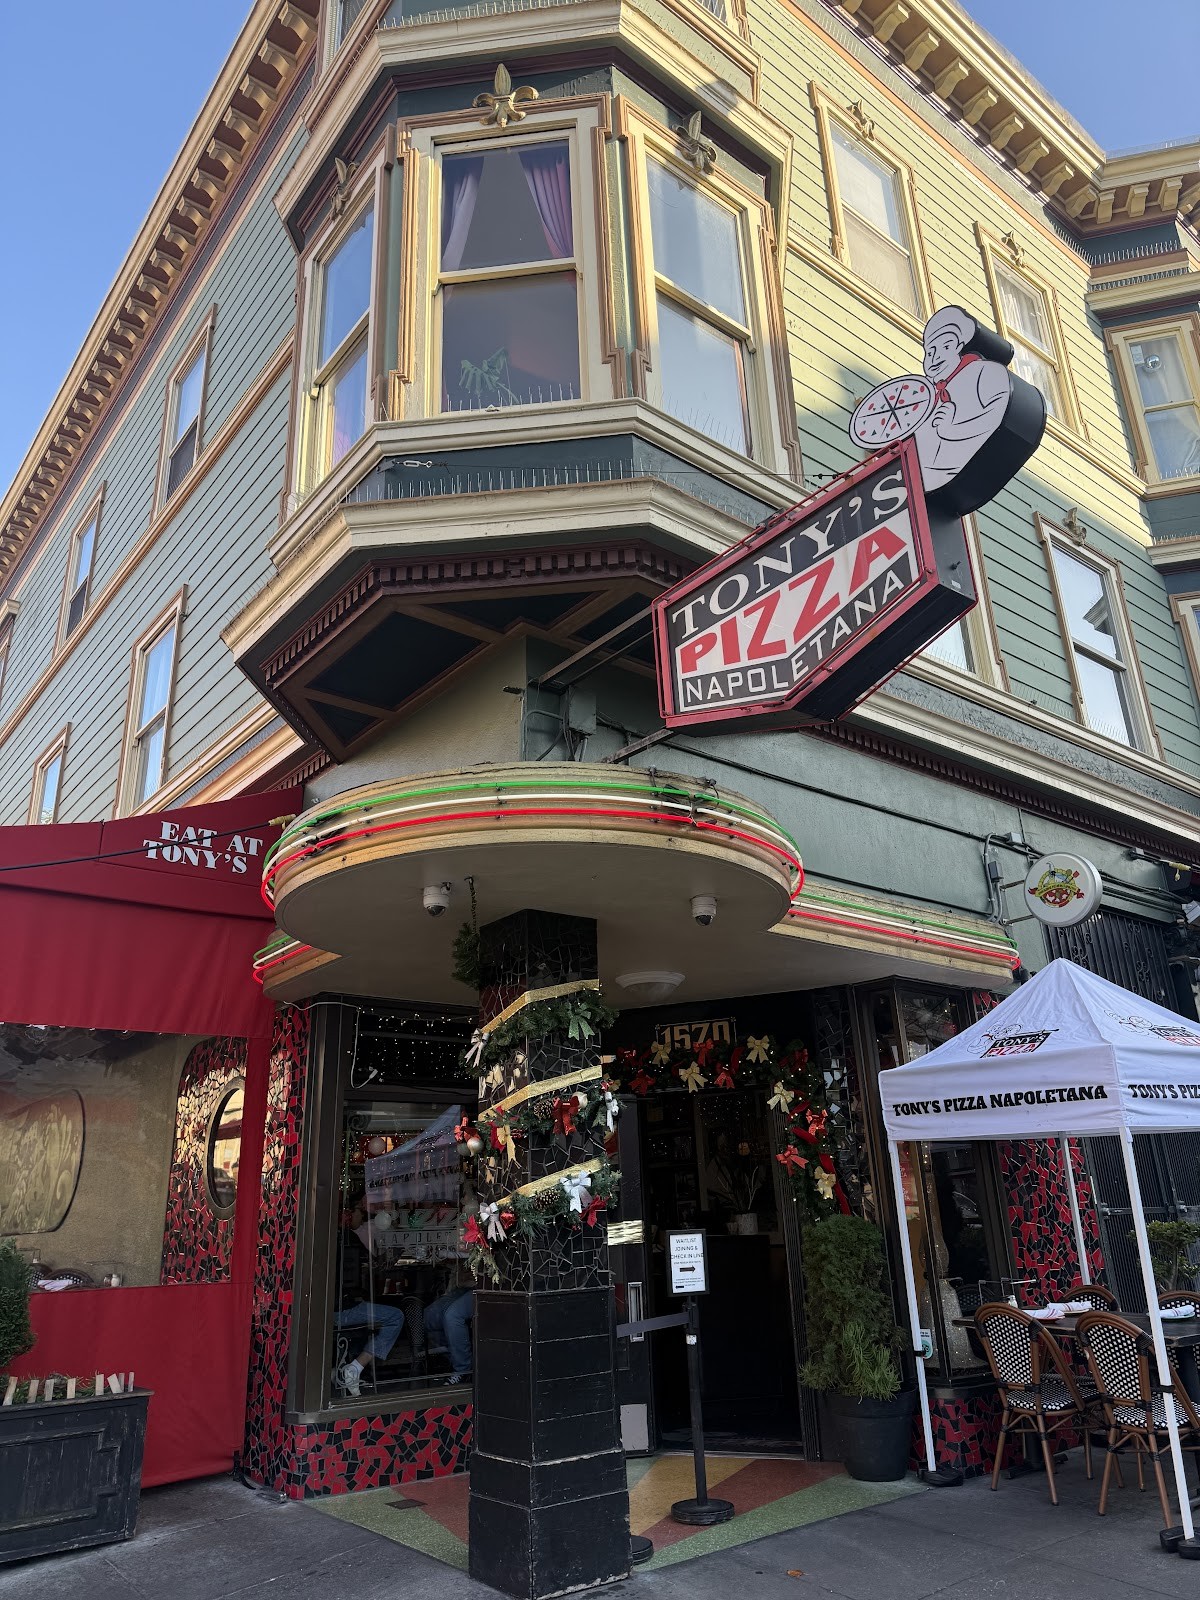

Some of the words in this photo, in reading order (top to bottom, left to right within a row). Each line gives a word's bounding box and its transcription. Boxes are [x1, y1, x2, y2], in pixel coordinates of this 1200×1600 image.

[672, 469, 908, 639] TONY'S
[680, 525, 908, 674] PIZZA
[685, 569, 905, 703] NAPOLETANA
[159, 820, 217, 848] EAT
[226, 834, 263, 857] AT
[143, 839, 248, 874] TONY'S
[660, 1021, 731, 1049] 1570
[988, 1043, 1037, 1056] PIZZA
[995, 1033, 1046, 1048] TONY'S
[892, 1099, 942, 1117] TONY'S
[943, 1095, 988, 1113] PIZZA
[989, 1085, 1108, 1109] NAPOLETANA
[1127, 1084, 1179, 1099] TONY'S
[1178, 1084, 1200, 1099] PIZ
